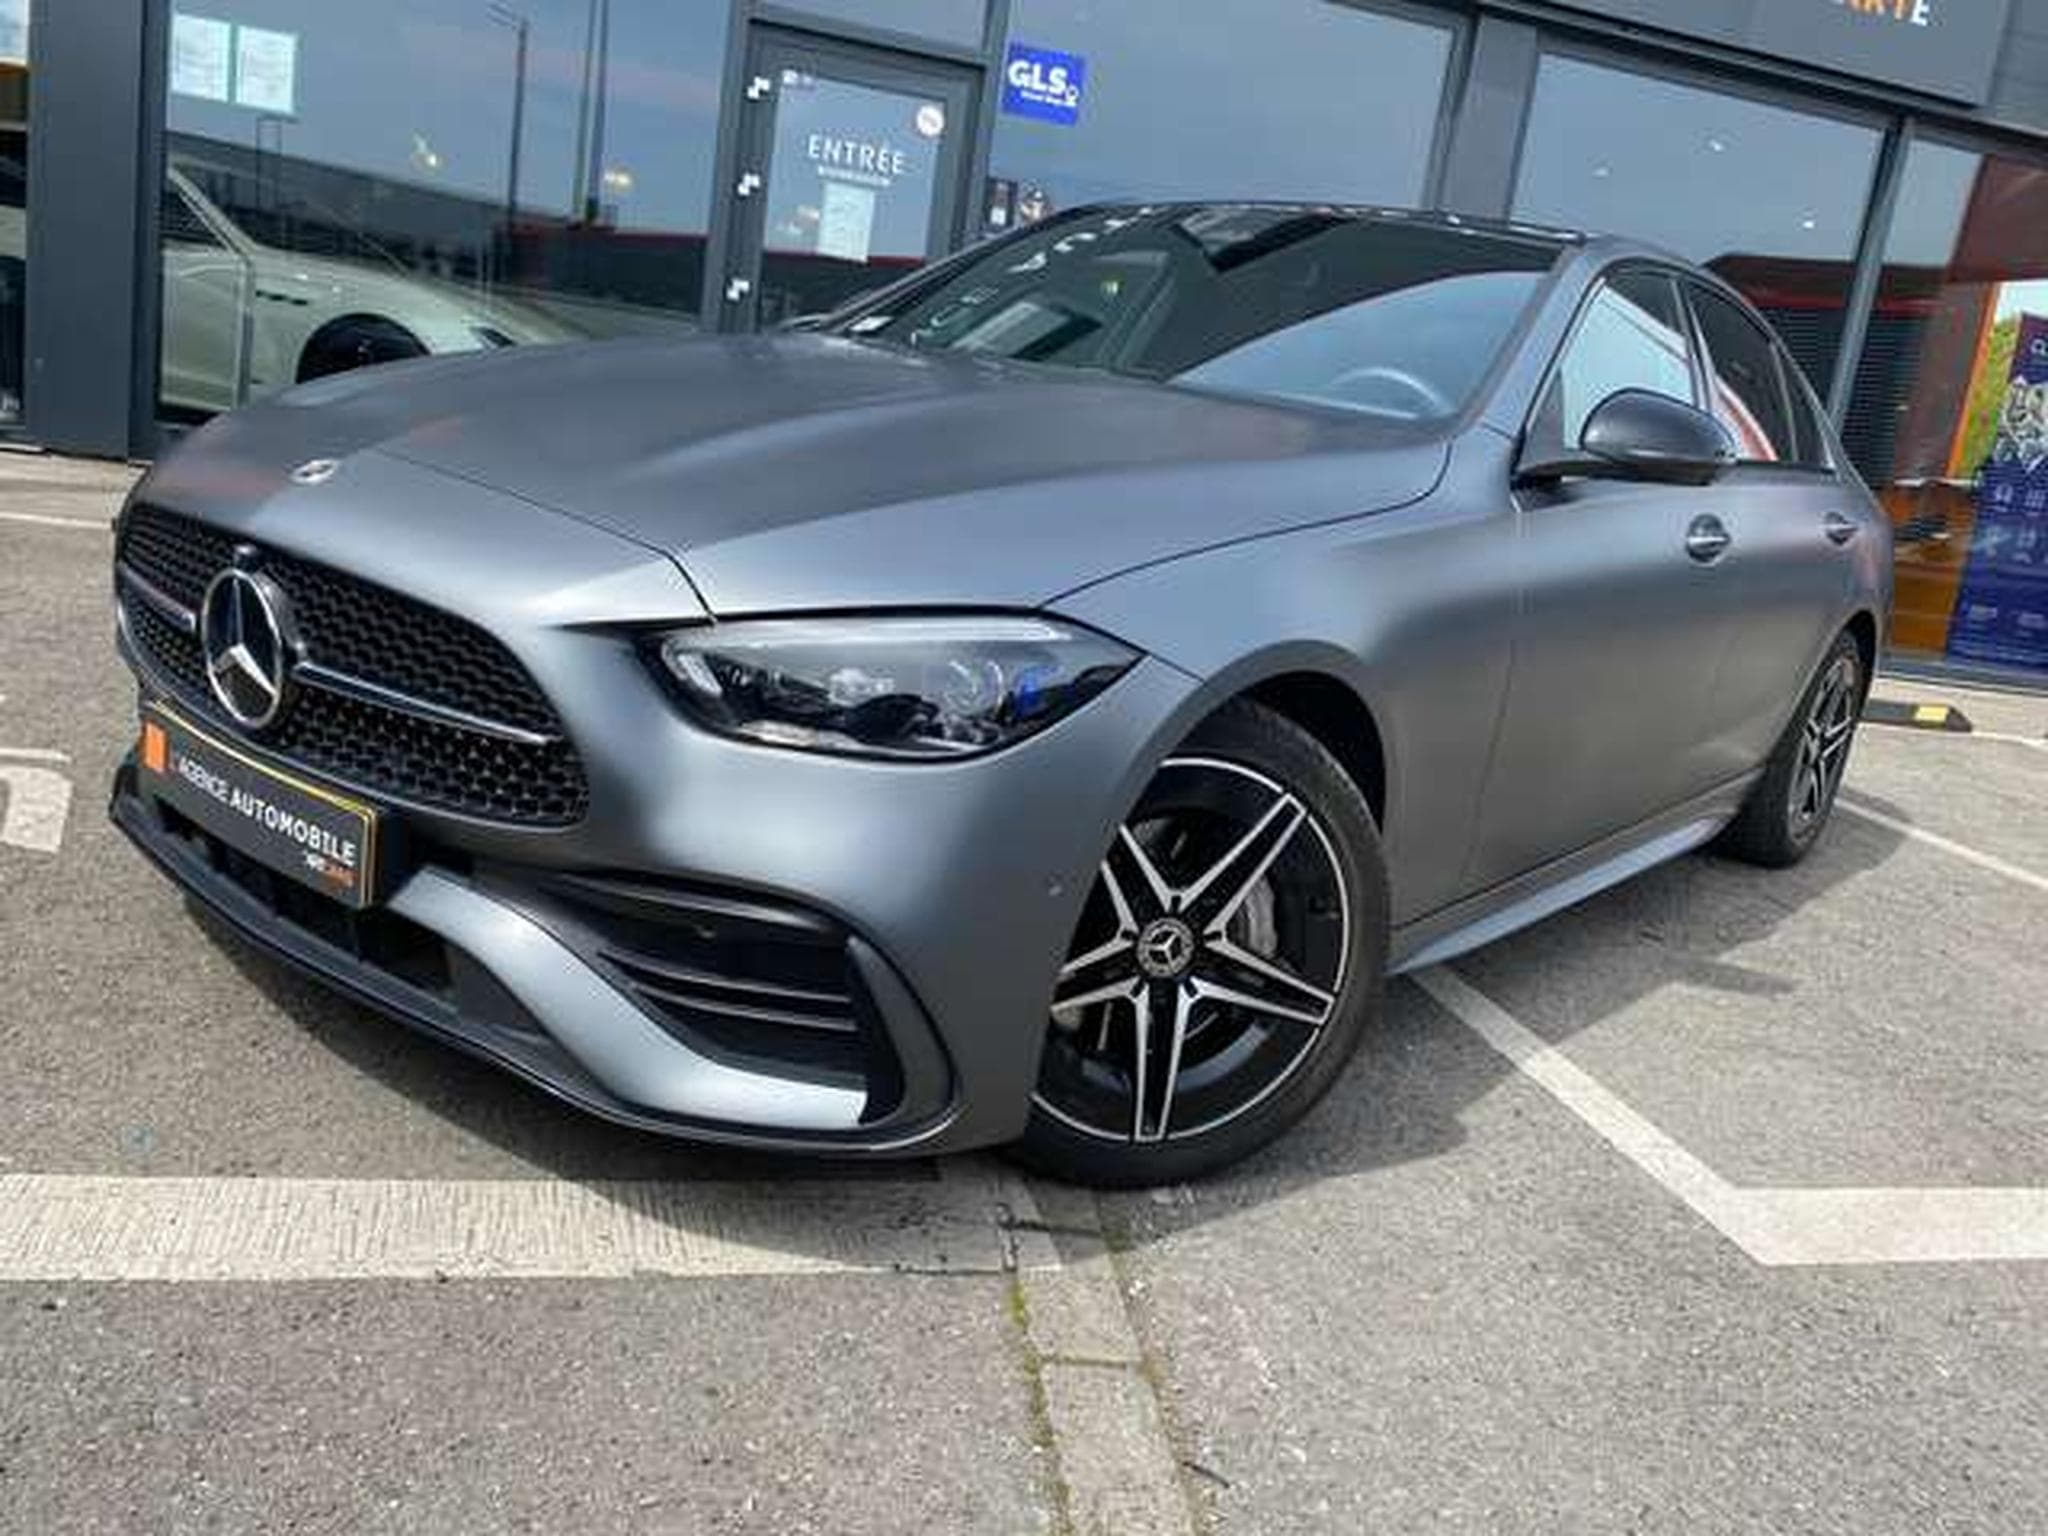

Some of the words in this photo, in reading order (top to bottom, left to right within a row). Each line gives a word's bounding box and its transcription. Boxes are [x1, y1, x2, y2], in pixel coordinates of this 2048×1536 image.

[1008, 59, 1068, 96] GLS
[807, 134, 906, 175] ENTRÉE
[229, 787, 356, 867] AUTOMOBILE
